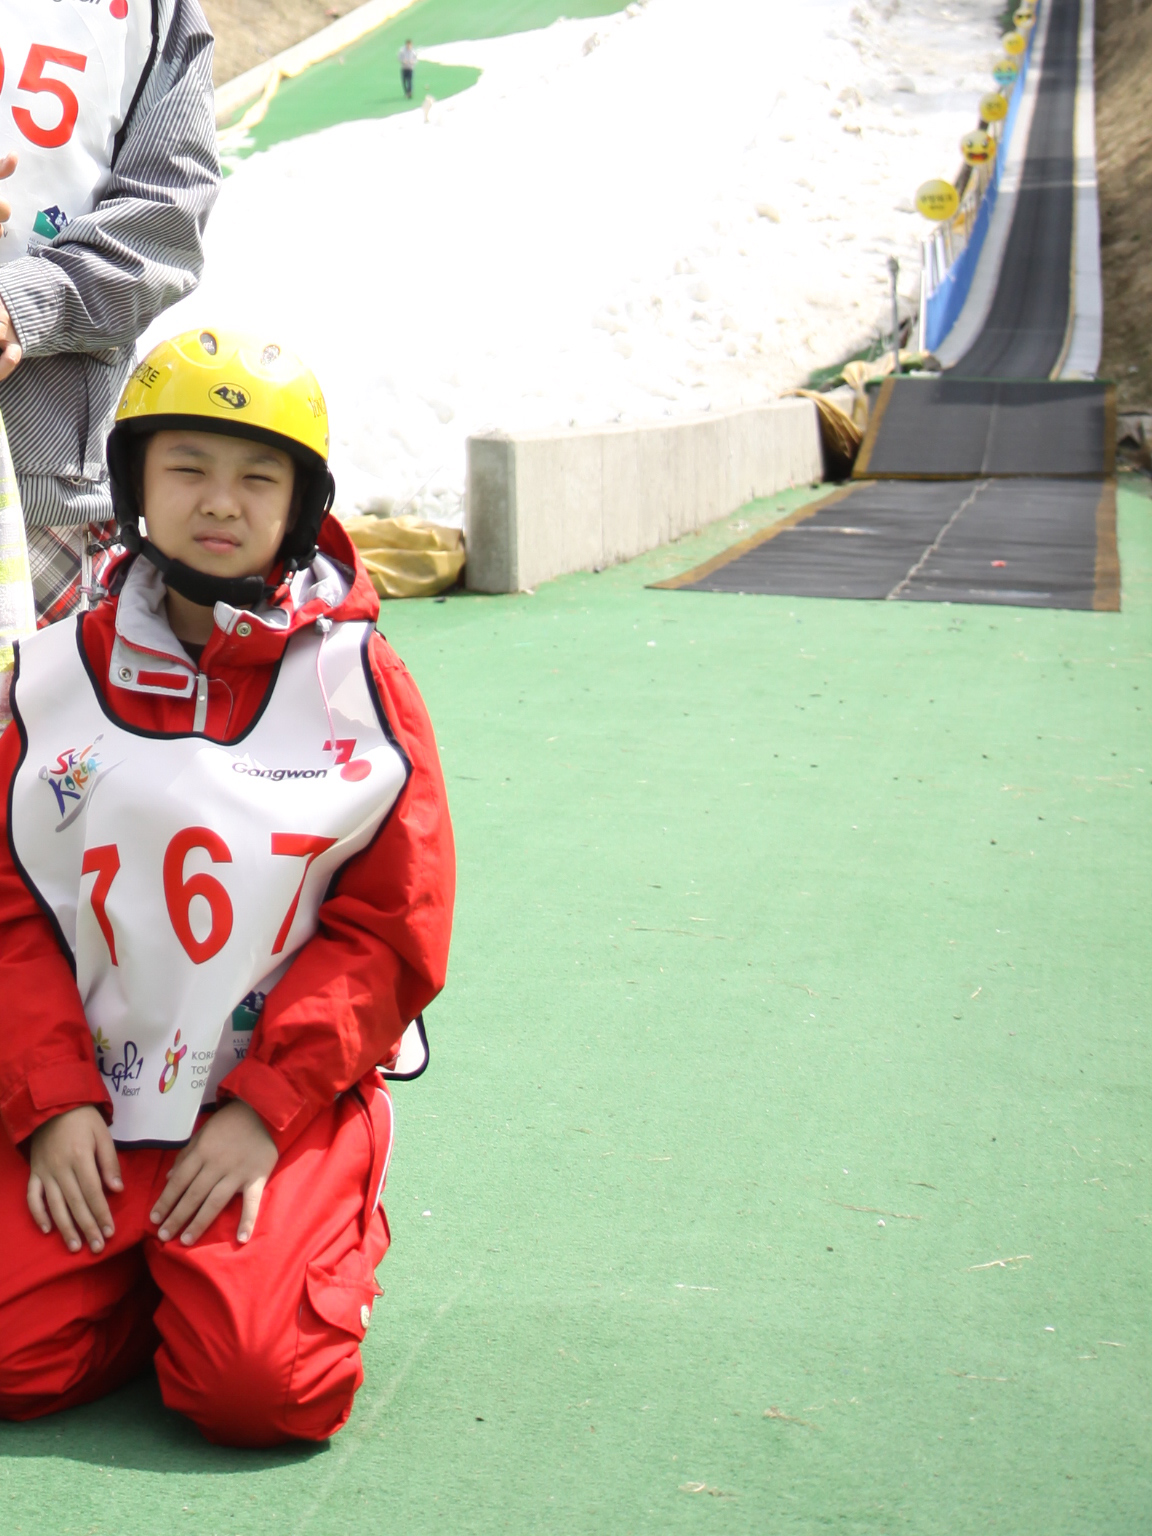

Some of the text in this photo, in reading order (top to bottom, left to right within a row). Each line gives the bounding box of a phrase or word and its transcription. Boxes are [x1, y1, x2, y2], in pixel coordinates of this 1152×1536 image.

[48, 758, 102, 819] KOREA
[232, 762, 328, 781] Gangwon
[80, 825, 339, 968] 767
